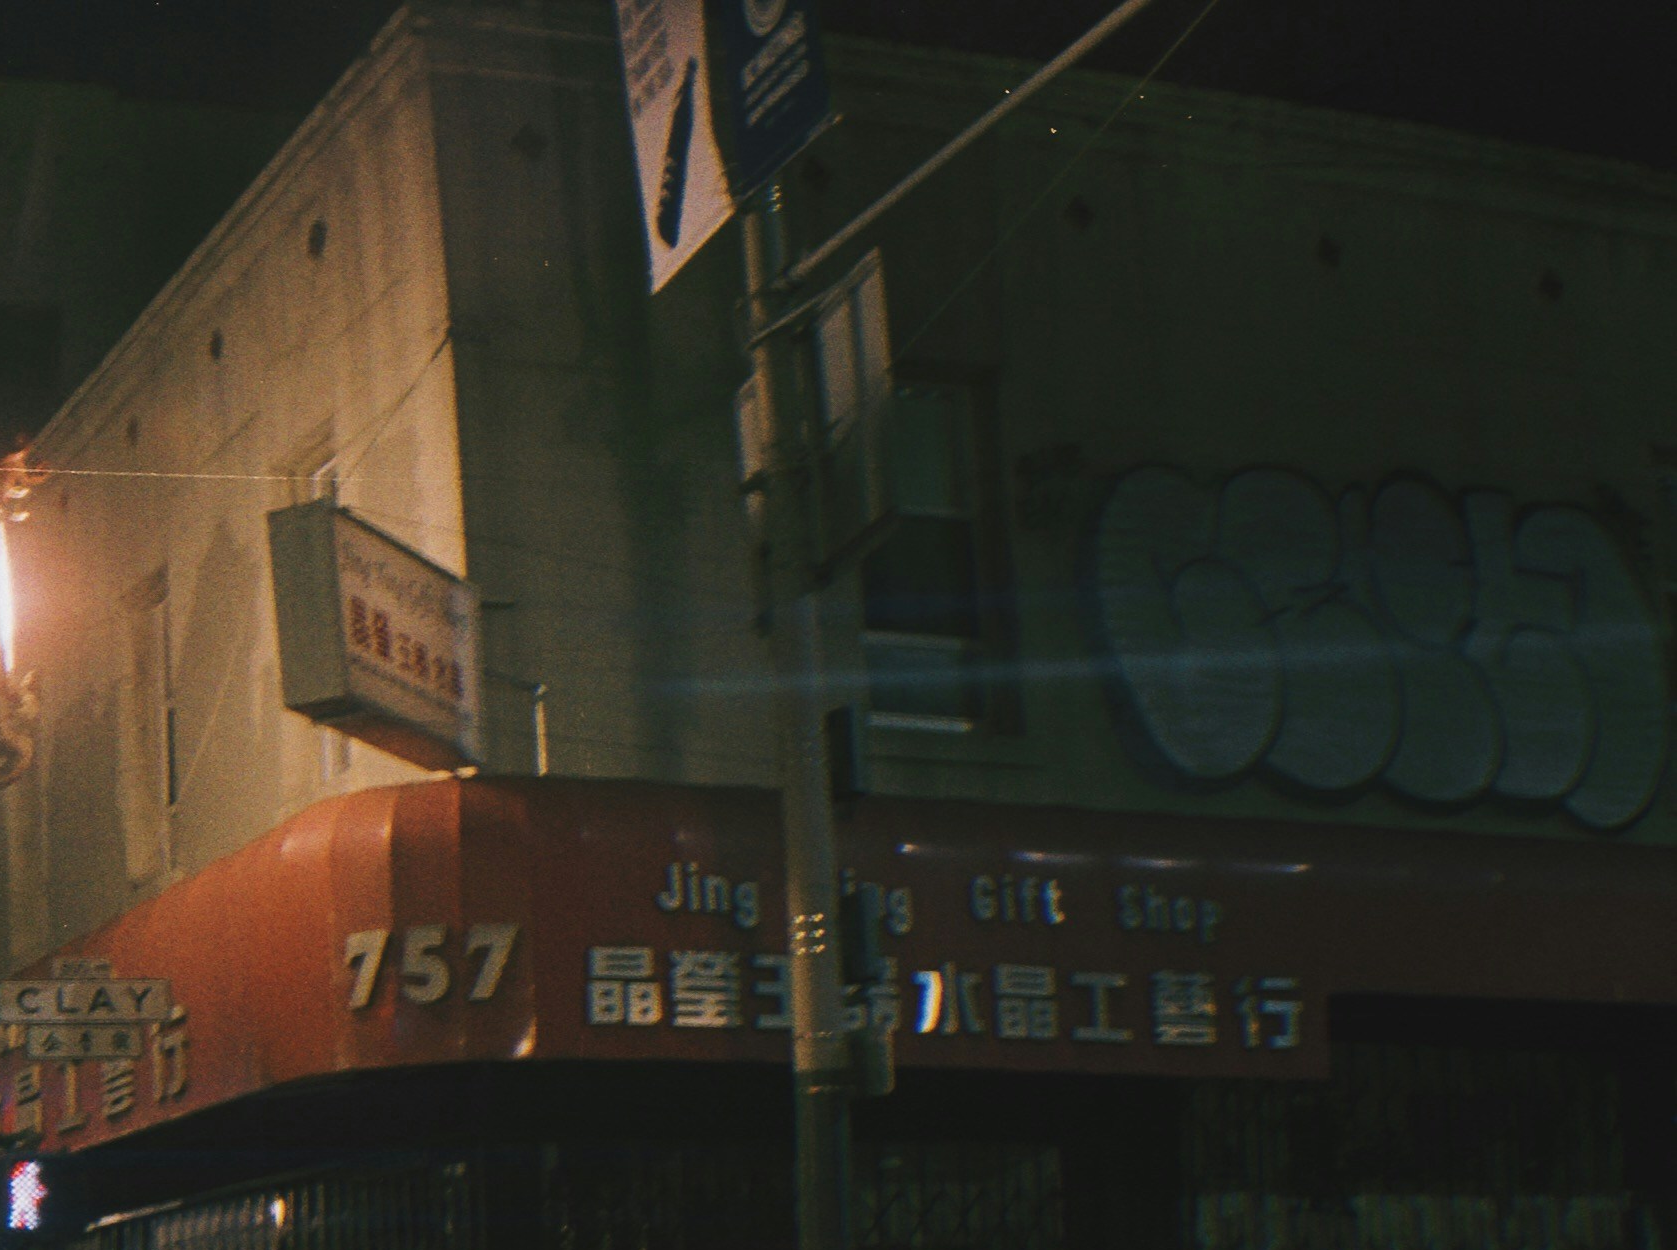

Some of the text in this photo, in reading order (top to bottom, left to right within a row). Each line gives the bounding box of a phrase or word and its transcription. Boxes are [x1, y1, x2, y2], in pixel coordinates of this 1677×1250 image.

[655, 860, 761, 929] Jing
[969, 874, 1066, 926] Gift
[1116, 883, 1224, 944] Shop
[15, 986, 152, 1015] CLAY
[344, 922, 522, 1011] 757
